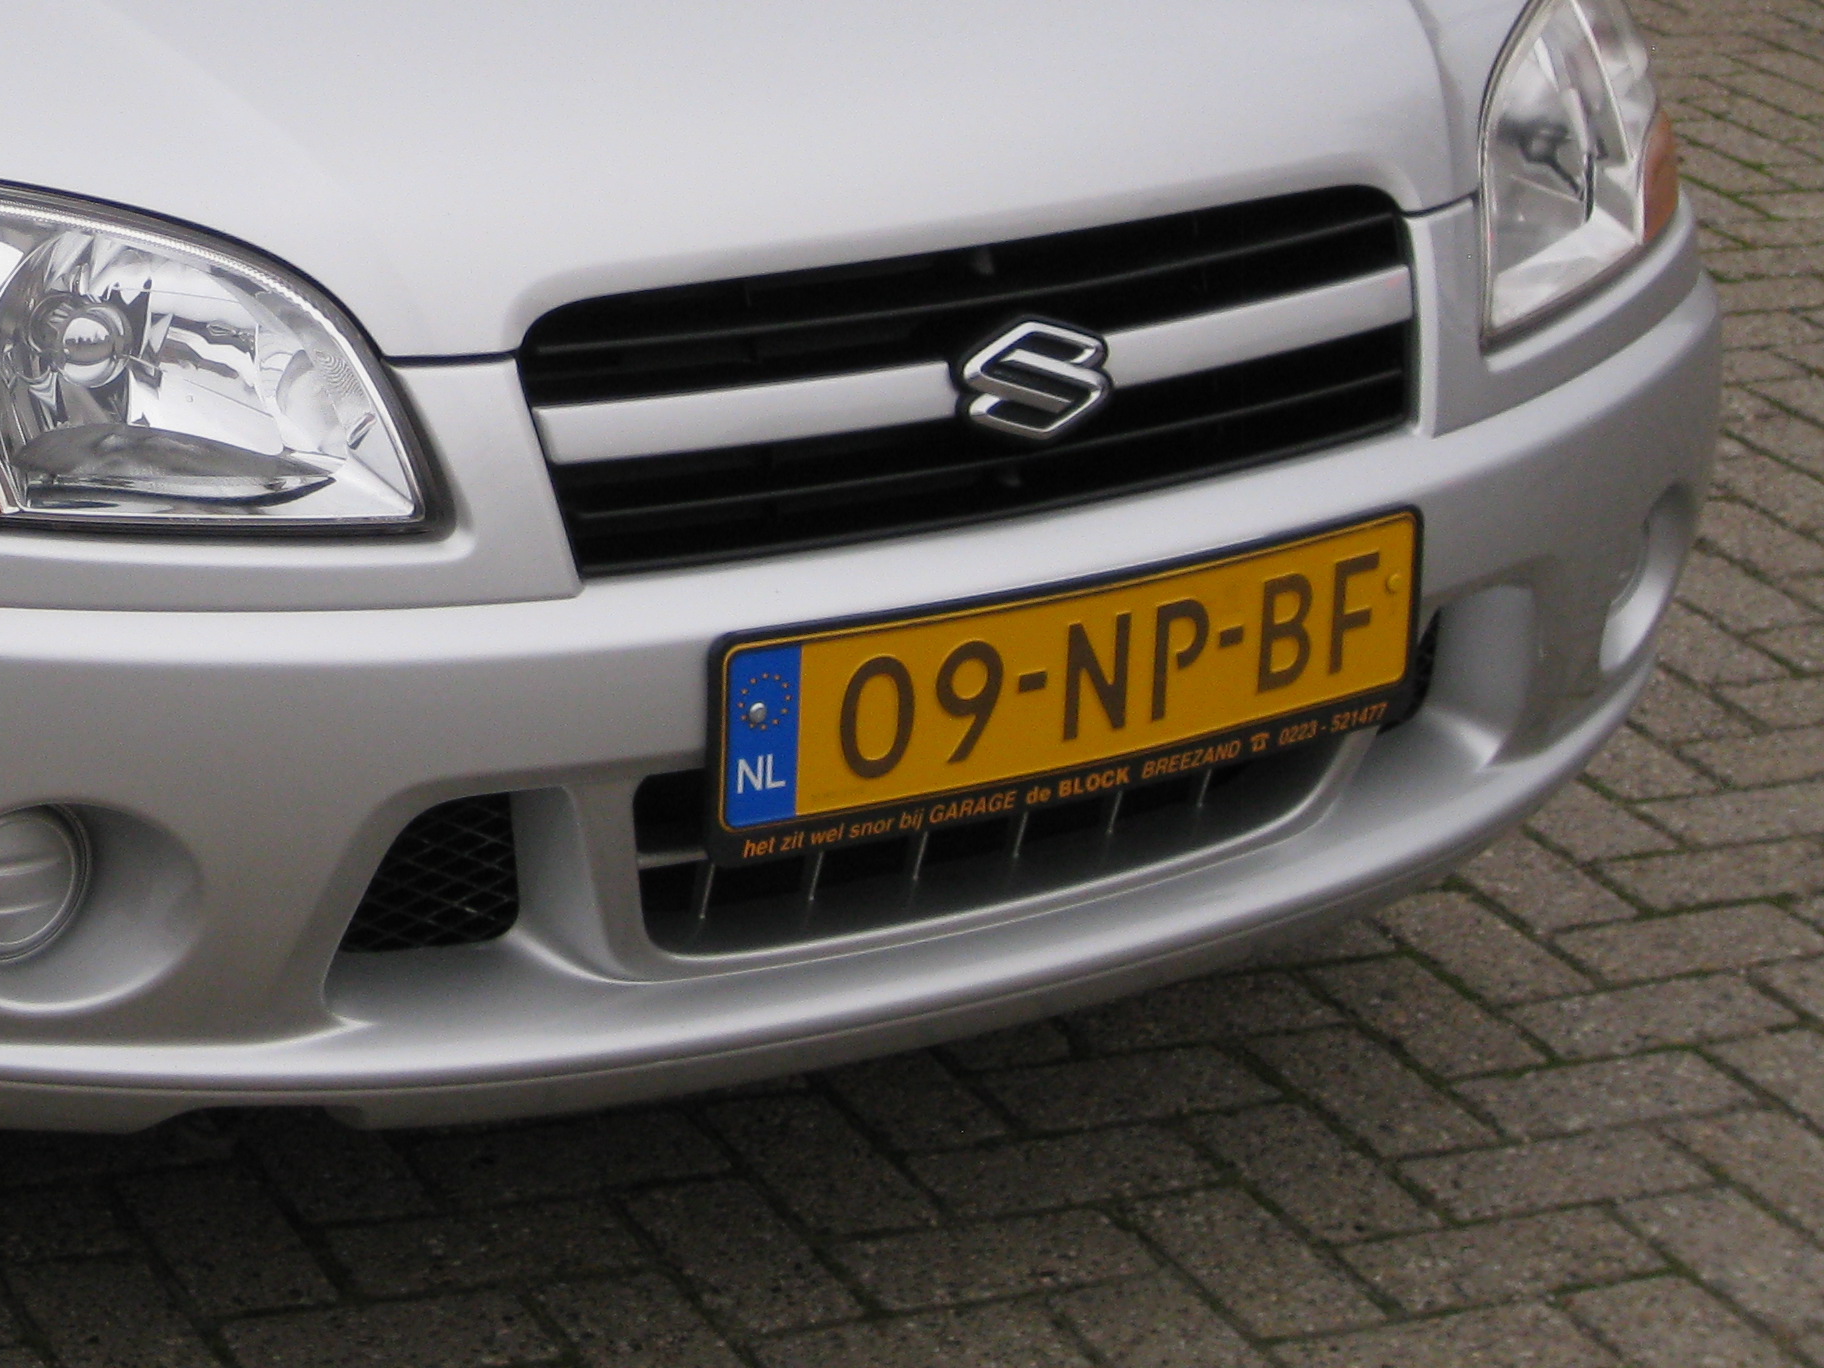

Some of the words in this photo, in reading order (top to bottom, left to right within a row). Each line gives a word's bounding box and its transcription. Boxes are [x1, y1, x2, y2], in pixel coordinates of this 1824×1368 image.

[839, 552, 1379, 778] 09-NP-BF
[737, 754, 785, 794] NL
[743, 838, 775, 858] het
[780, 833, 804, 851] zit
[811, 824, 843, 844] wel
[849, 819, 894, 838] snor
[899, 809, 924, 830] bij
[929, 790, 1017, 824] GARAGE
[1026, 785, 1051, 805] de
[1058, 766, 1130, 798] BLOCK
[1141, 741, 1241, 779] BREEZAND
[1279, 720, 1318, 745] 0223
[1330, 702, 1388, 732] 521477
